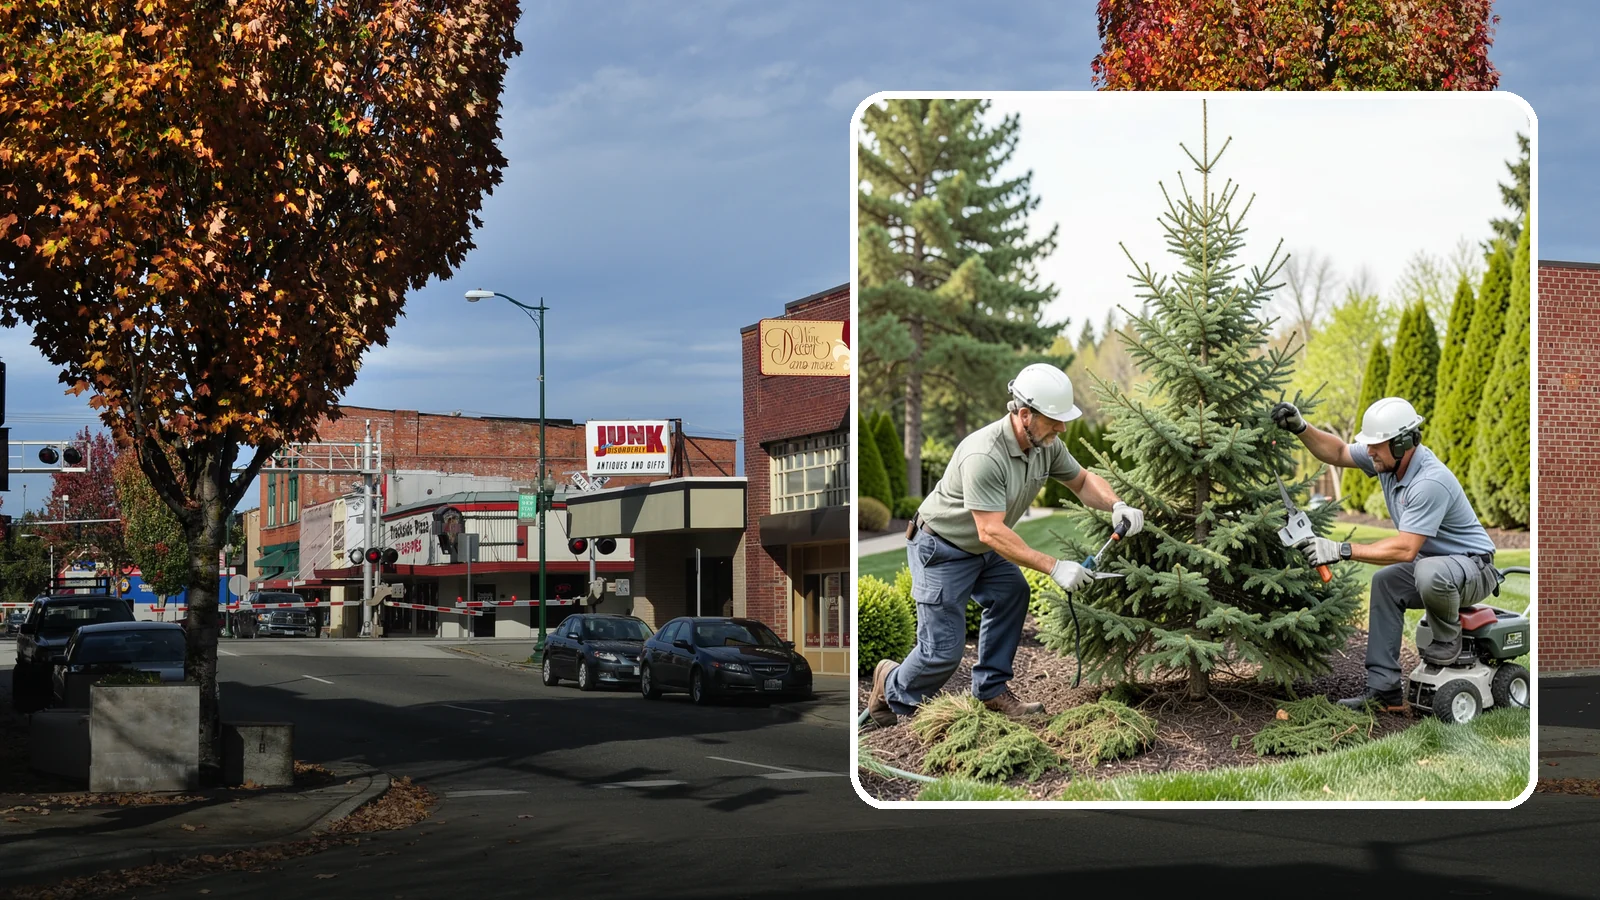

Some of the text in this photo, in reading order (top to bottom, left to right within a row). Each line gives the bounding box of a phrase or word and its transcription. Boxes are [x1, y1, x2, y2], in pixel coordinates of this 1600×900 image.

[765, 327, 831, 365] Decor
[596, 425, 665, 457] JUNK
[607, 446, 646, 454] DISORDERLY
[597, 460, 665, 470] ANTIQUES AND GIFTS
[415, 520, 429, 535] Pizza
